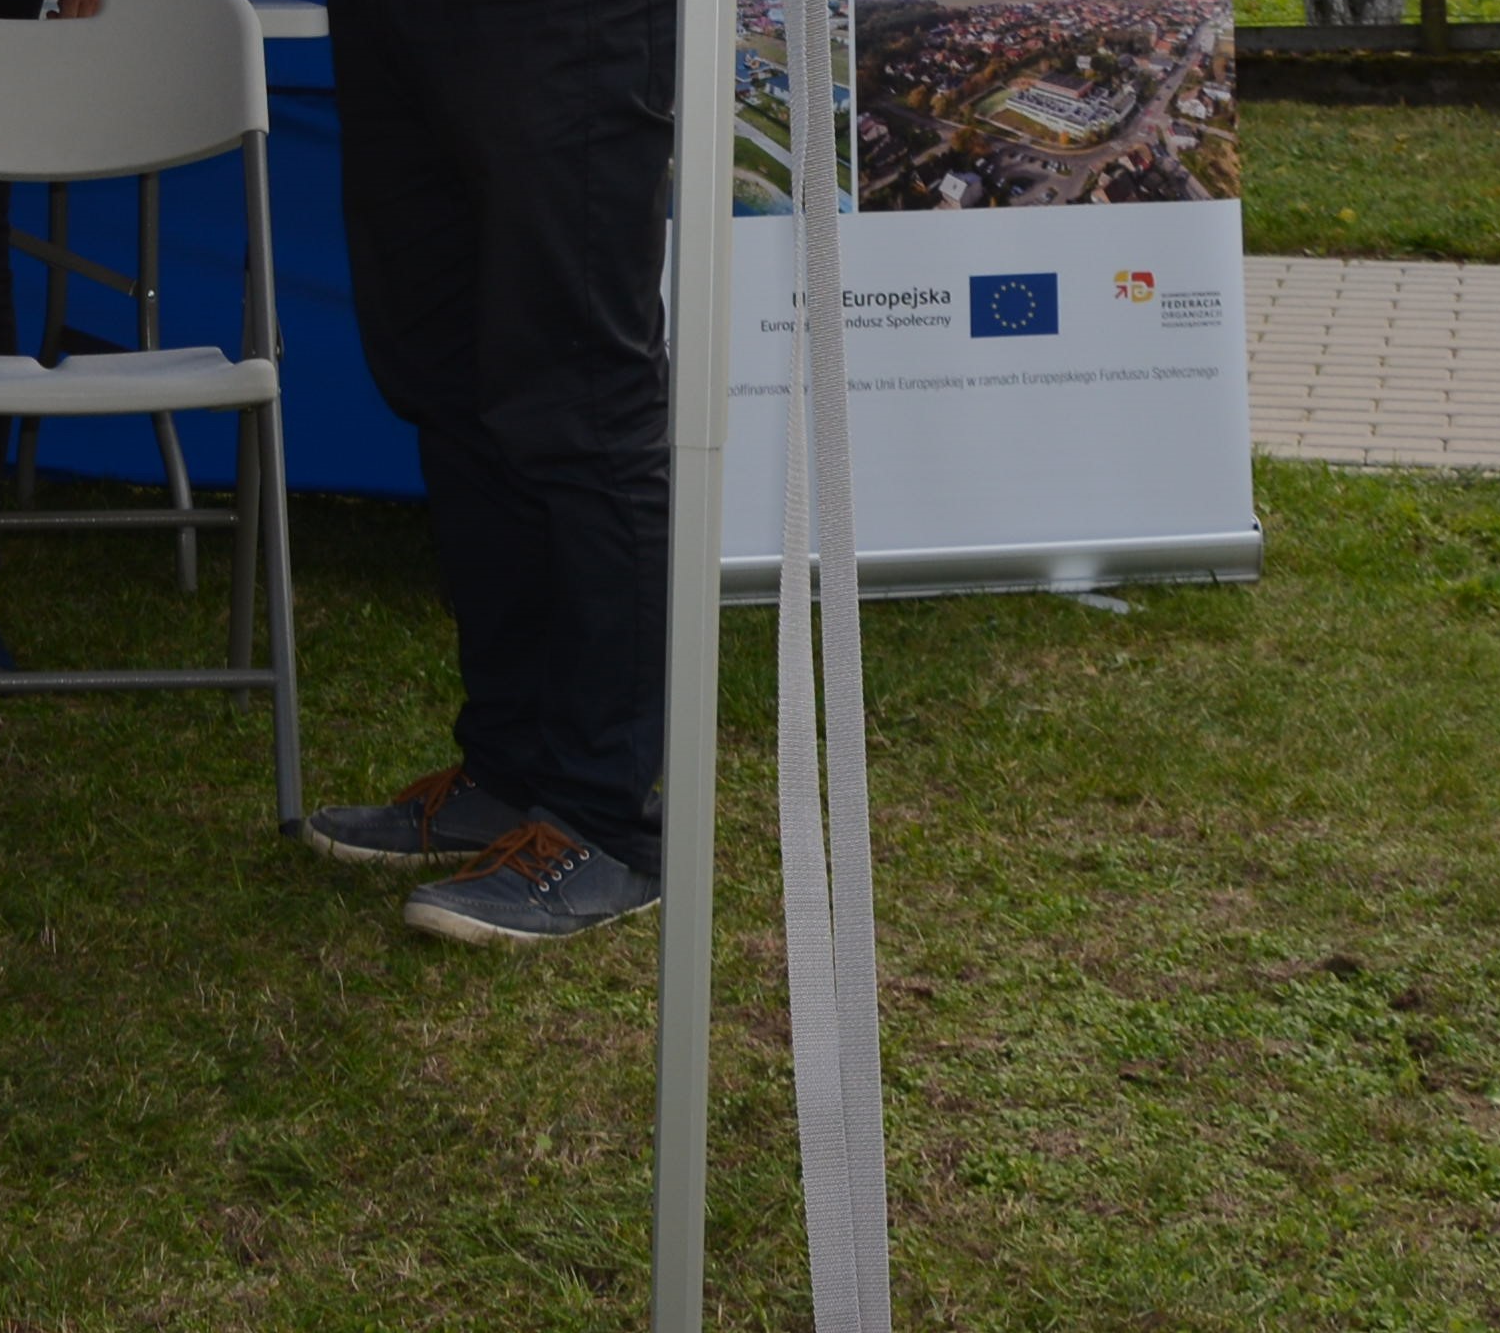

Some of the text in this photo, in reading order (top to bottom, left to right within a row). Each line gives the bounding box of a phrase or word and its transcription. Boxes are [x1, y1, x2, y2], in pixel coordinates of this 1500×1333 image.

[842, 287, 952, 310] Europejska
[846, 316, 883, 329] ndusz
[886, 314, 952, 330] Społeczny
[898, 375, 964, 393] Europejskiej
[966, 377, 976, 388] w
[979, 372, 1019, 387] ramach
[1022, 369, 1097, 386] Europejskiego
[1099, 368, 1150, 381] Funduszu
[1152, 365, 1219, 381] Społecznego
